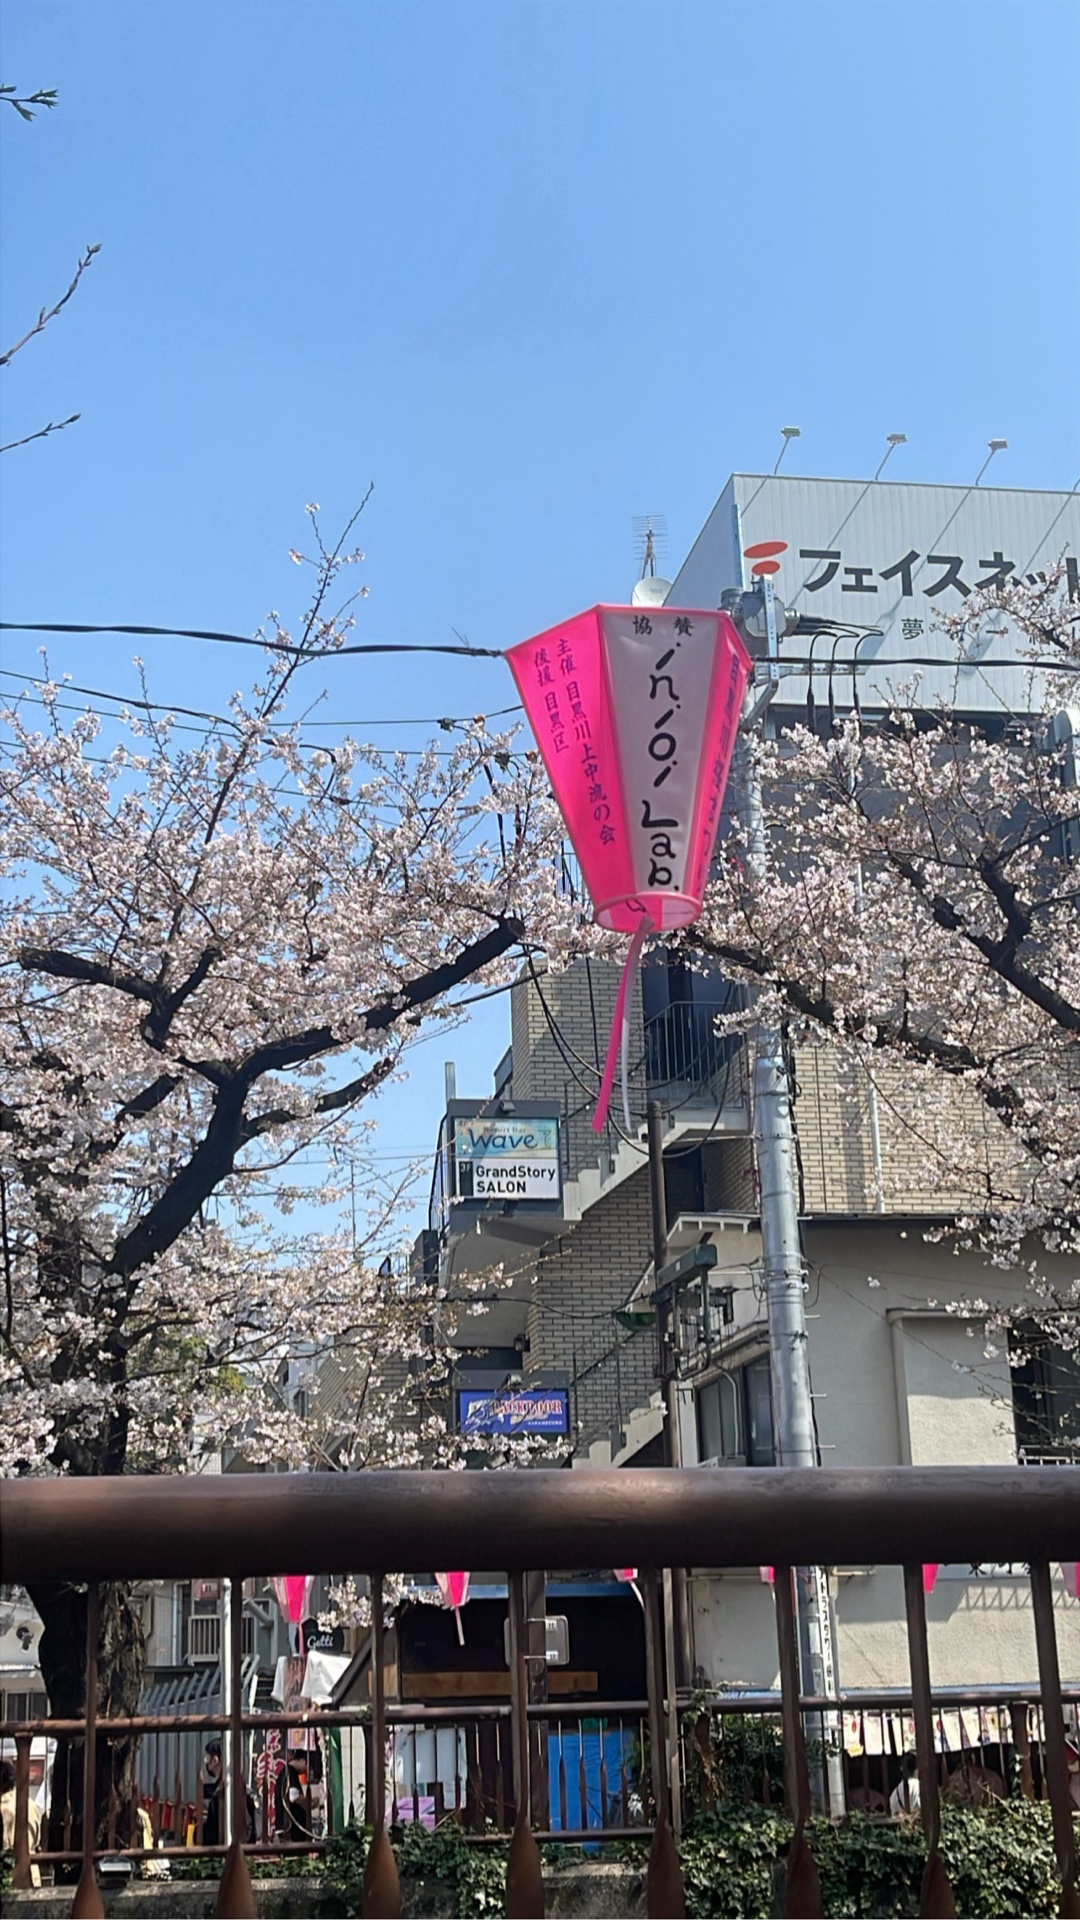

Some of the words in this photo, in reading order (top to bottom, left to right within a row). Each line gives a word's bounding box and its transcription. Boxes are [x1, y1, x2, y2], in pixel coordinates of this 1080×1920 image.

[632, 615, 695, 637] 協賛
[557, 638, 577, 677] 主催
[533, 648, 555, 687] 後援
[544, 691, 569, 754] 目黒区
[566, 681, 616, 846] 目黒川上中流の会
[476, 1165, 556, 1181] GrandStory
[476, 1180, 527, 1193] SALON
